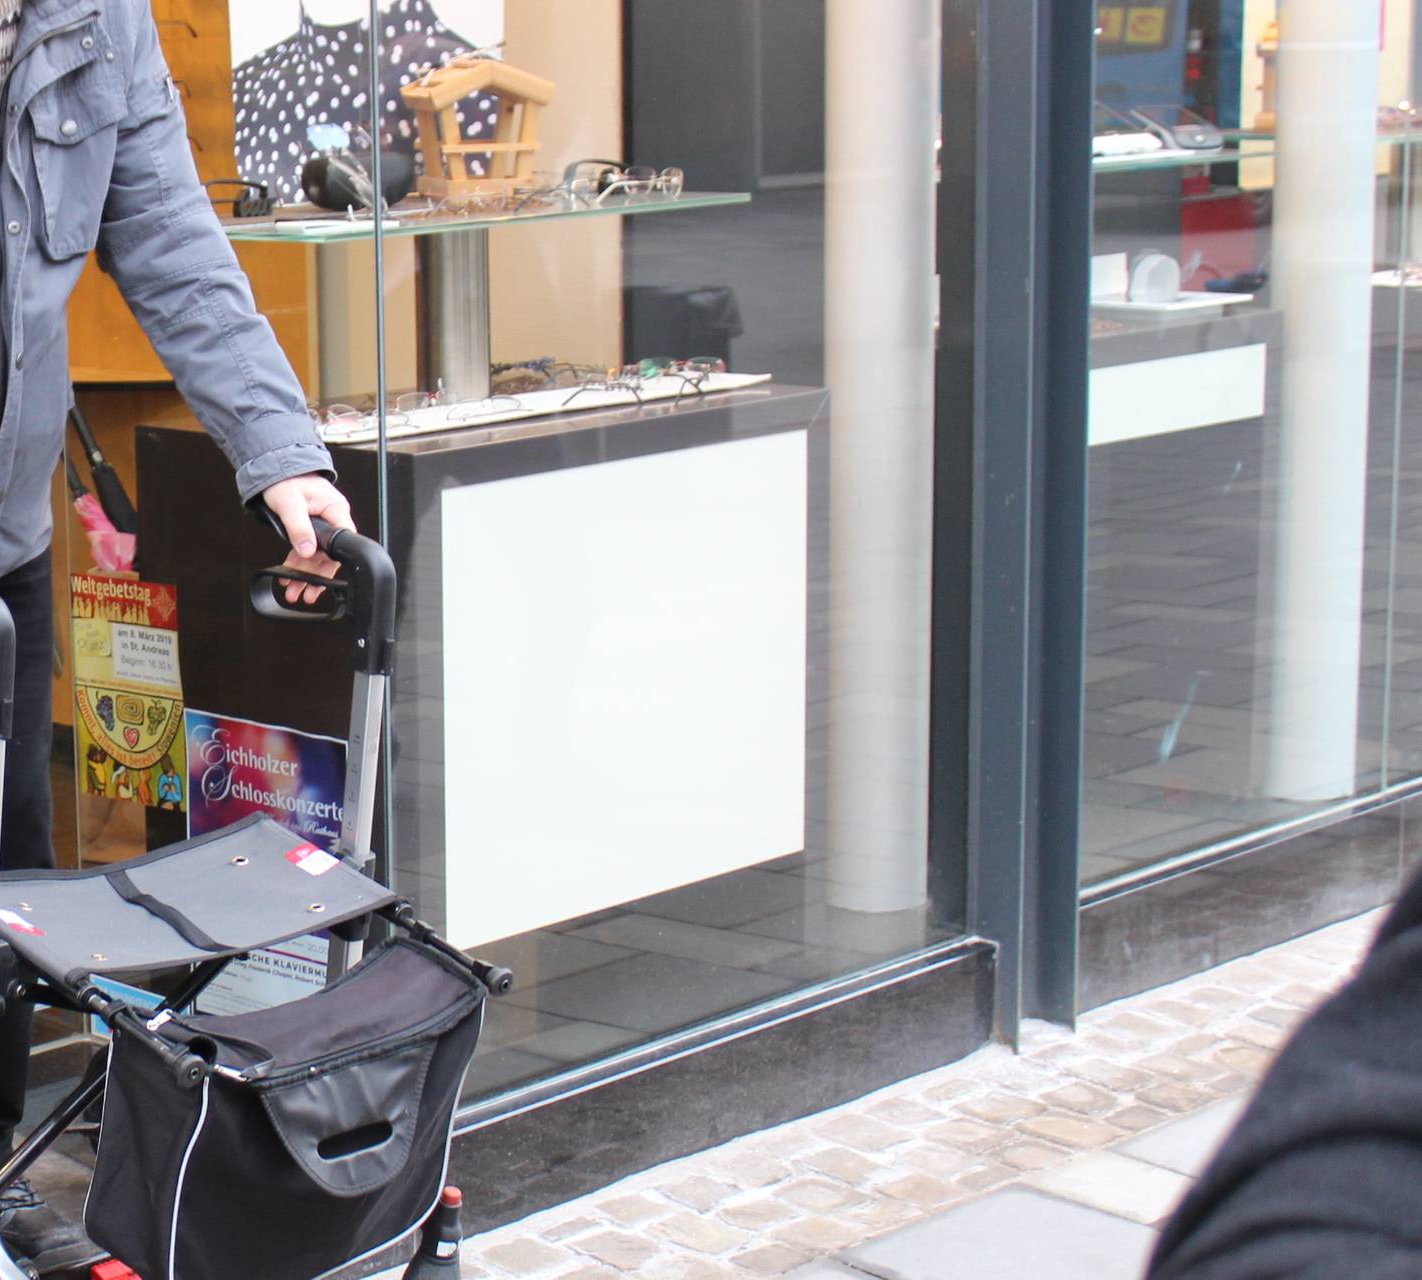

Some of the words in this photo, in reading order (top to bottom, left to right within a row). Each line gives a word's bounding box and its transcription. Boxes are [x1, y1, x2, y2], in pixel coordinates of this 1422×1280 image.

[70, 575, 152, 606] Weltgebetstag
[117, 630, 129, 638] am
[138, 631, 156, 642] März
[156, 633, 173, 645] 2019
[121, 642, 129, 650] in
[130, 642, 140, 652] St.
[141, 645, 171, 657] Andreas
[191, 724, 298, 777] Eichholzer
[201, 765, 343, 822] Schlosskonzerte
